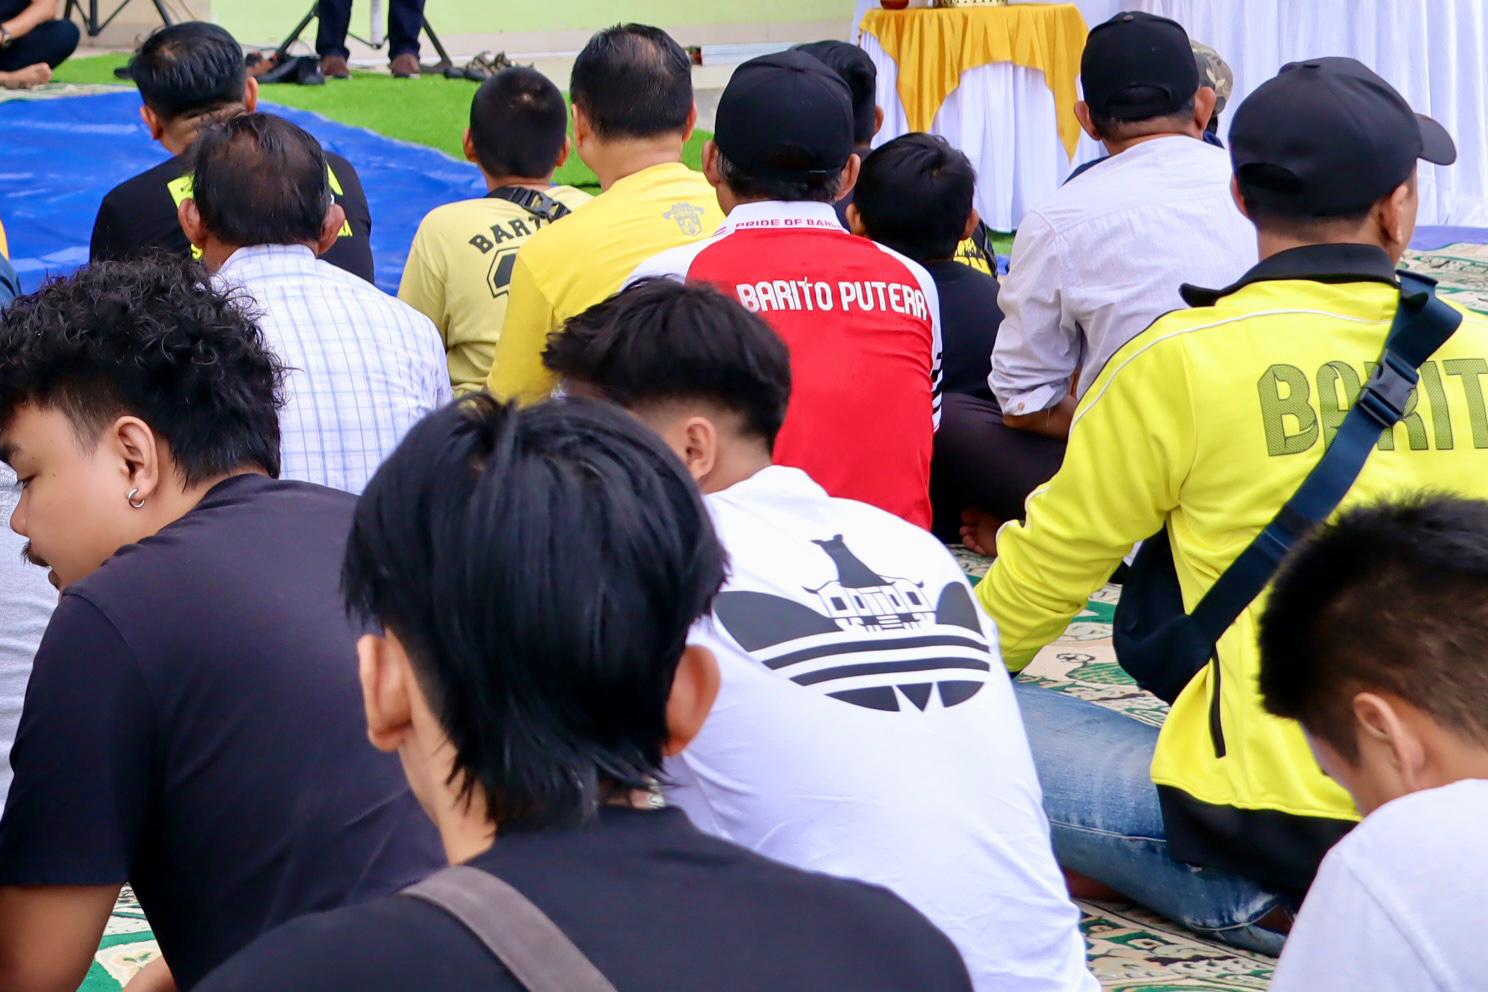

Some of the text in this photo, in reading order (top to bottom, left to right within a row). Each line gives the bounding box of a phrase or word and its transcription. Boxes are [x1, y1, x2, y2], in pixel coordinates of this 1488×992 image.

[736, 219, 780, 228] PRIDE
[736, 276, 928, 320] BARITO PUTERA
